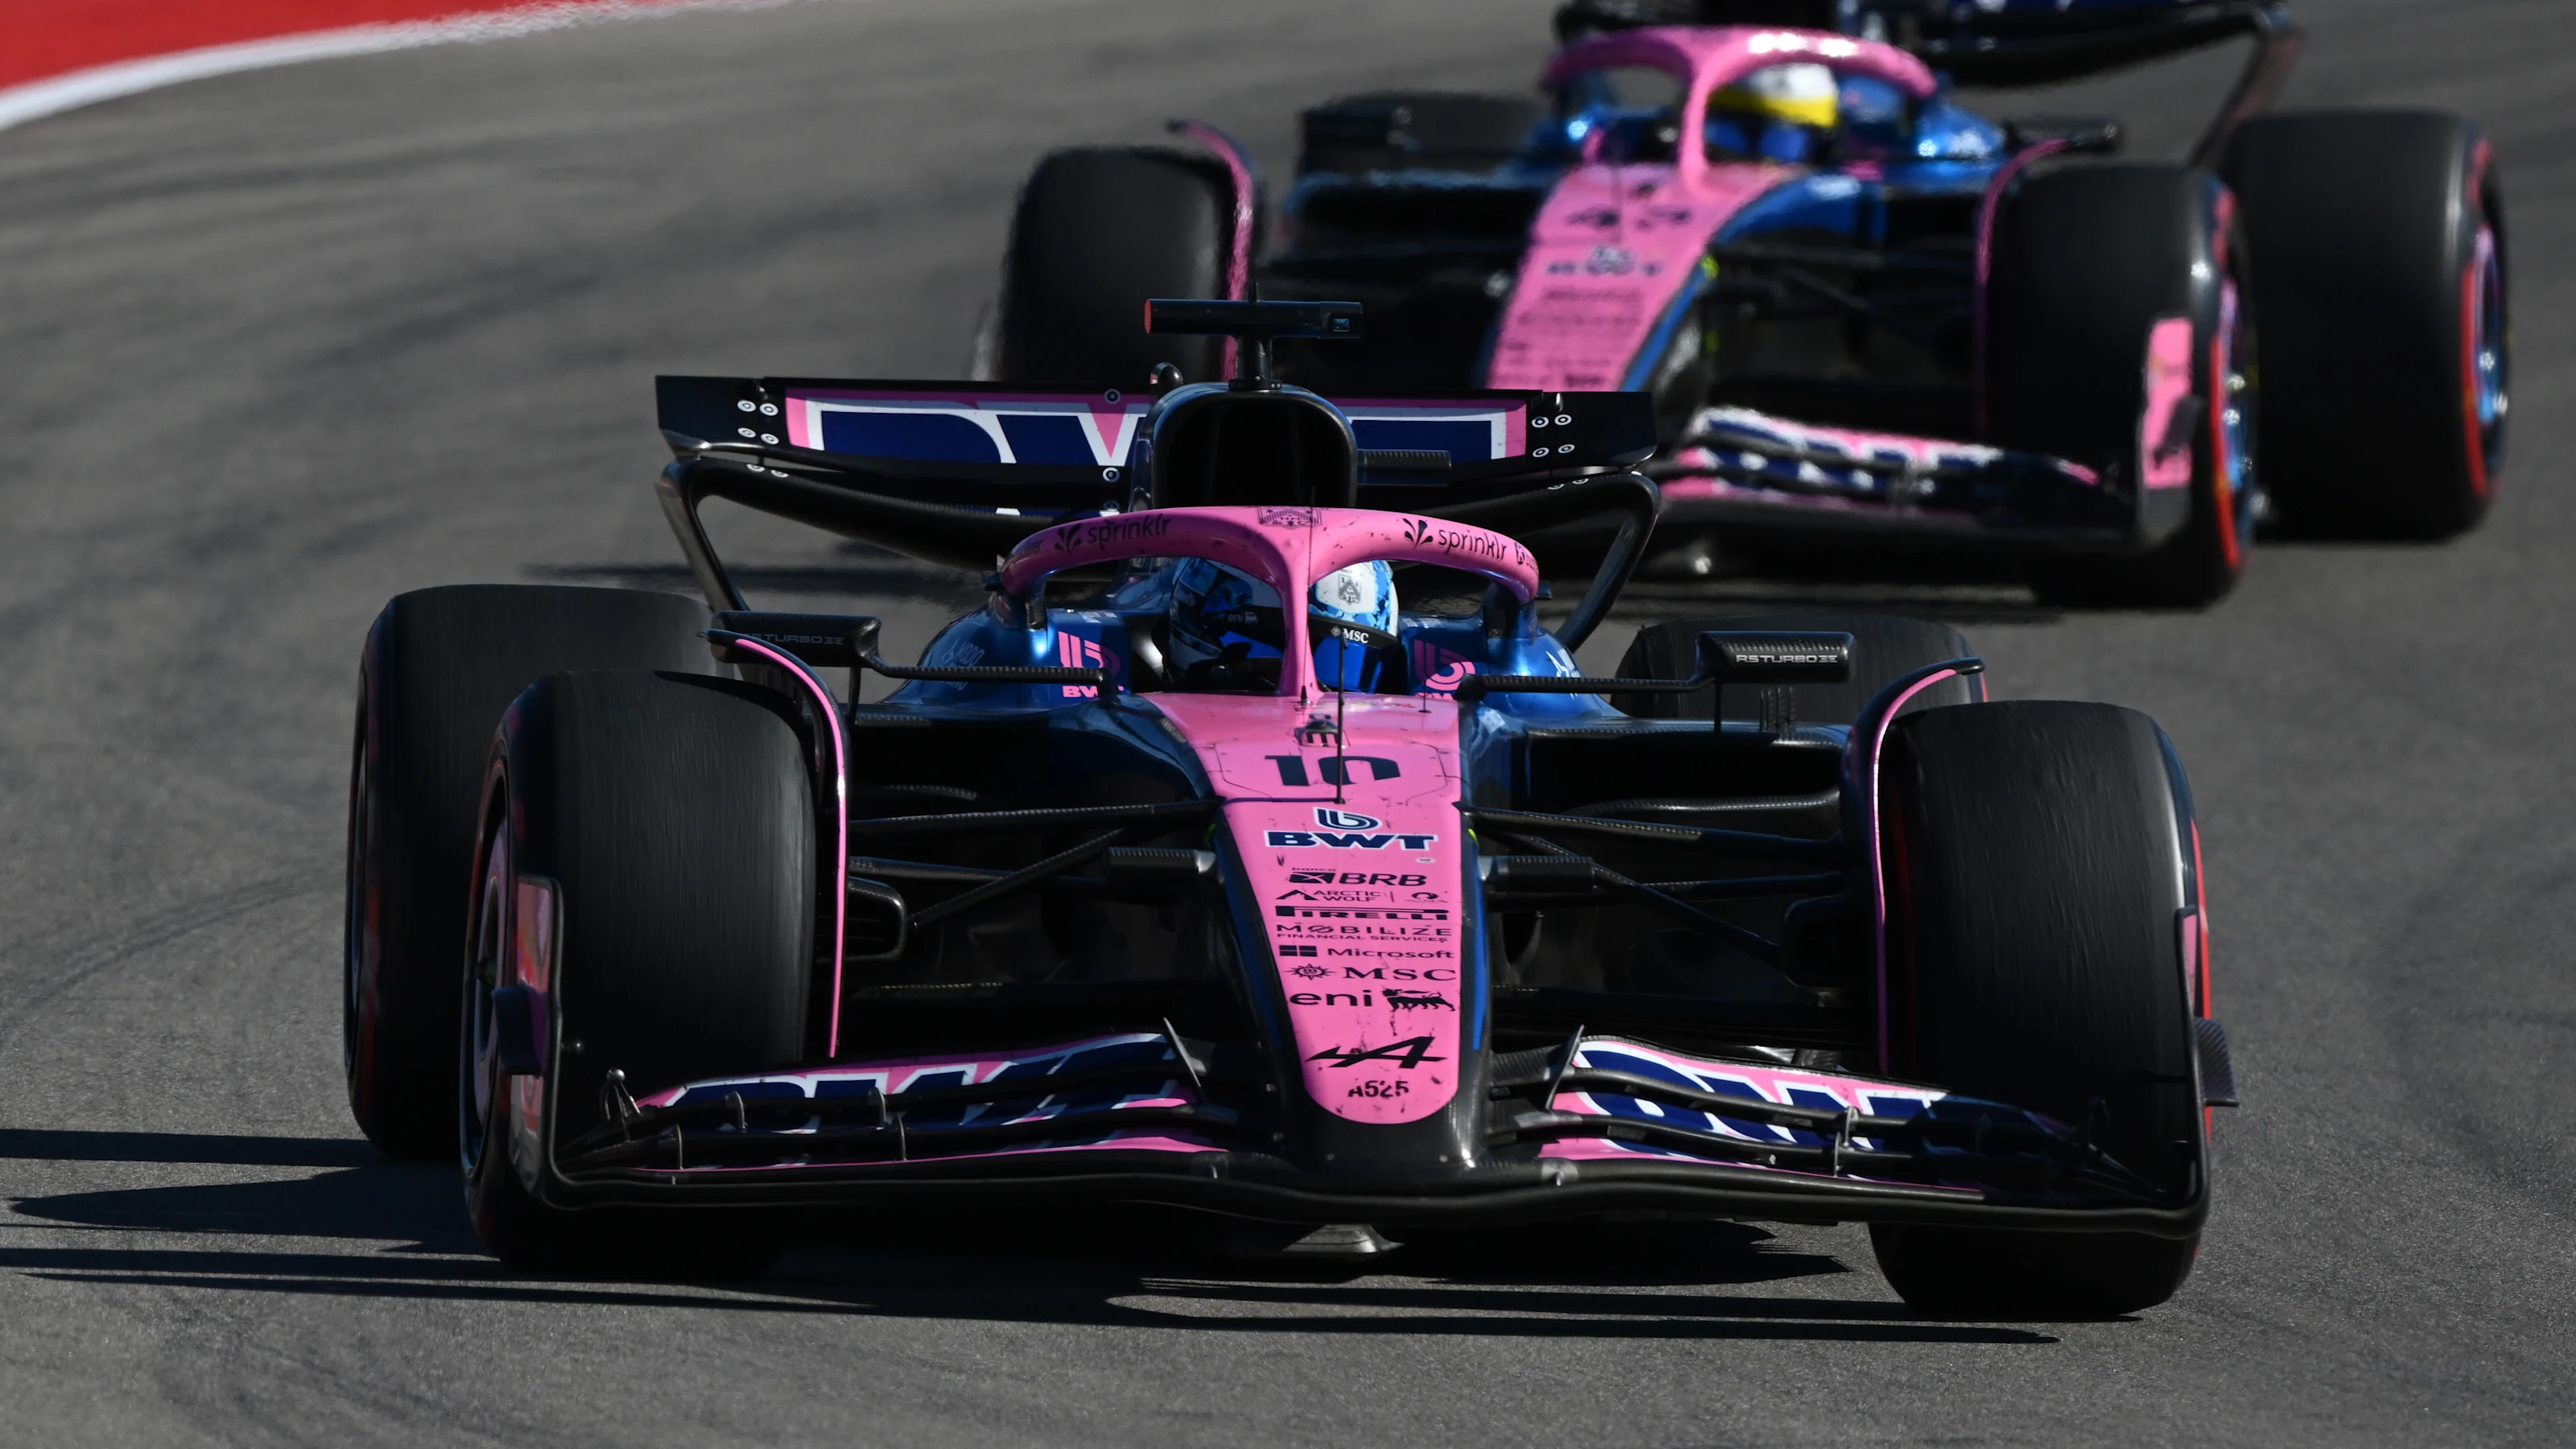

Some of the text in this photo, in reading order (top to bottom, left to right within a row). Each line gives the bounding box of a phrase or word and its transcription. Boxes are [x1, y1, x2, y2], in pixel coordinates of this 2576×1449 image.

[1088, 513, 1171, 551] sprinklr
[1439, 529, 1507, 560] sprinklr
[1227, 612, 1244, 622] eni
[1343, 629, 1369, 644] MSC
[1062, 686, 1124, 698] BW
[1265, 755, 1401, 786] 10
[1265, 830, 1438, 850] BWT
[1339, 873, 1426, 886] BRB
[1275, 906, 1449, 920] PIRELLI
[1328, 948, 1455, 959] Microsoft
[1342, 967, 1457, 981] MSC
[1290, 989, 1373, 1007] eni
[1348, 1080, 1410, 1098] A525
